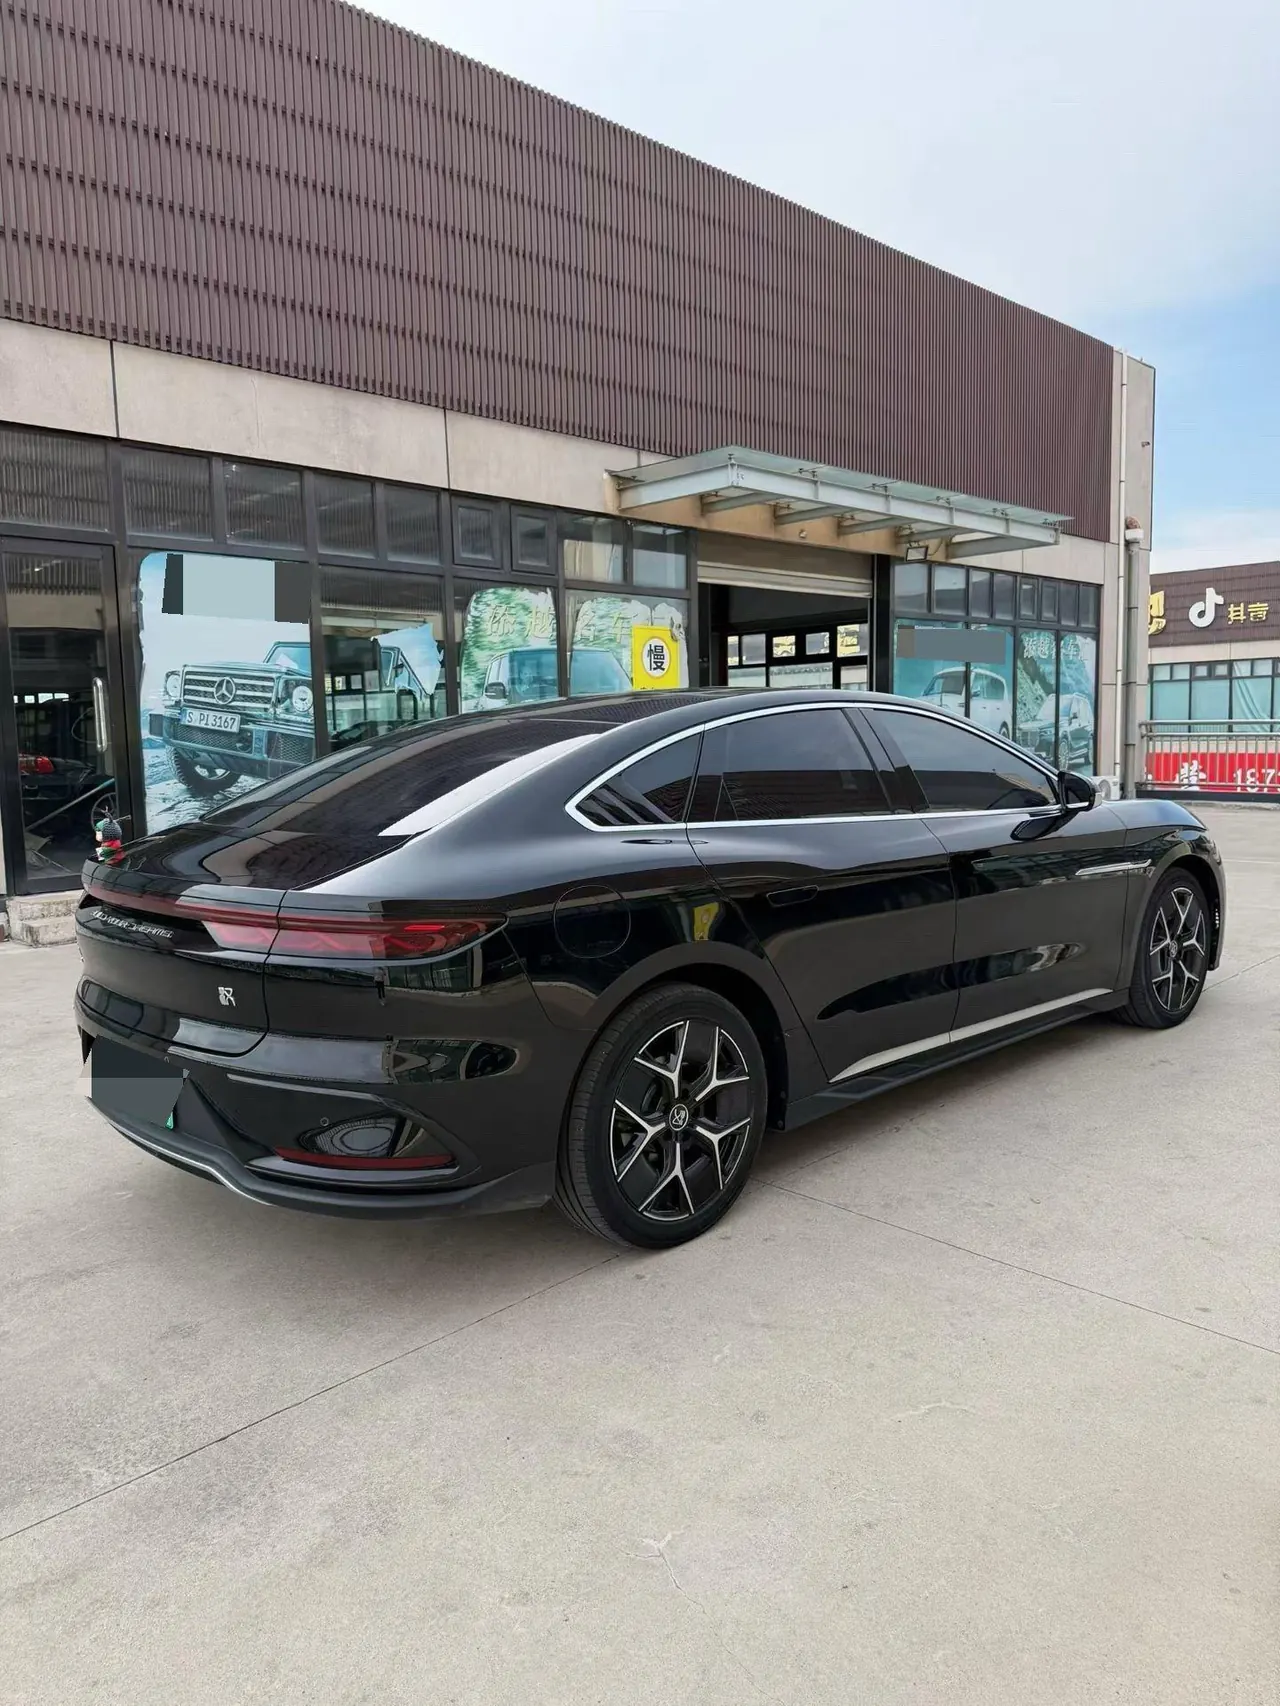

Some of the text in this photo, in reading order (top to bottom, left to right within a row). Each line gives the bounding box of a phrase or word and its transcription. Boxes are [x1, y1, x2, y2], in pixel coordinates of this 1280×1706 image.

[1227, 602, 1269, 624] 抖音
[646, 643, 666, 672] 慢
[187, 711, 194, 723] S
[1232, 767, 1280, 793] 187
